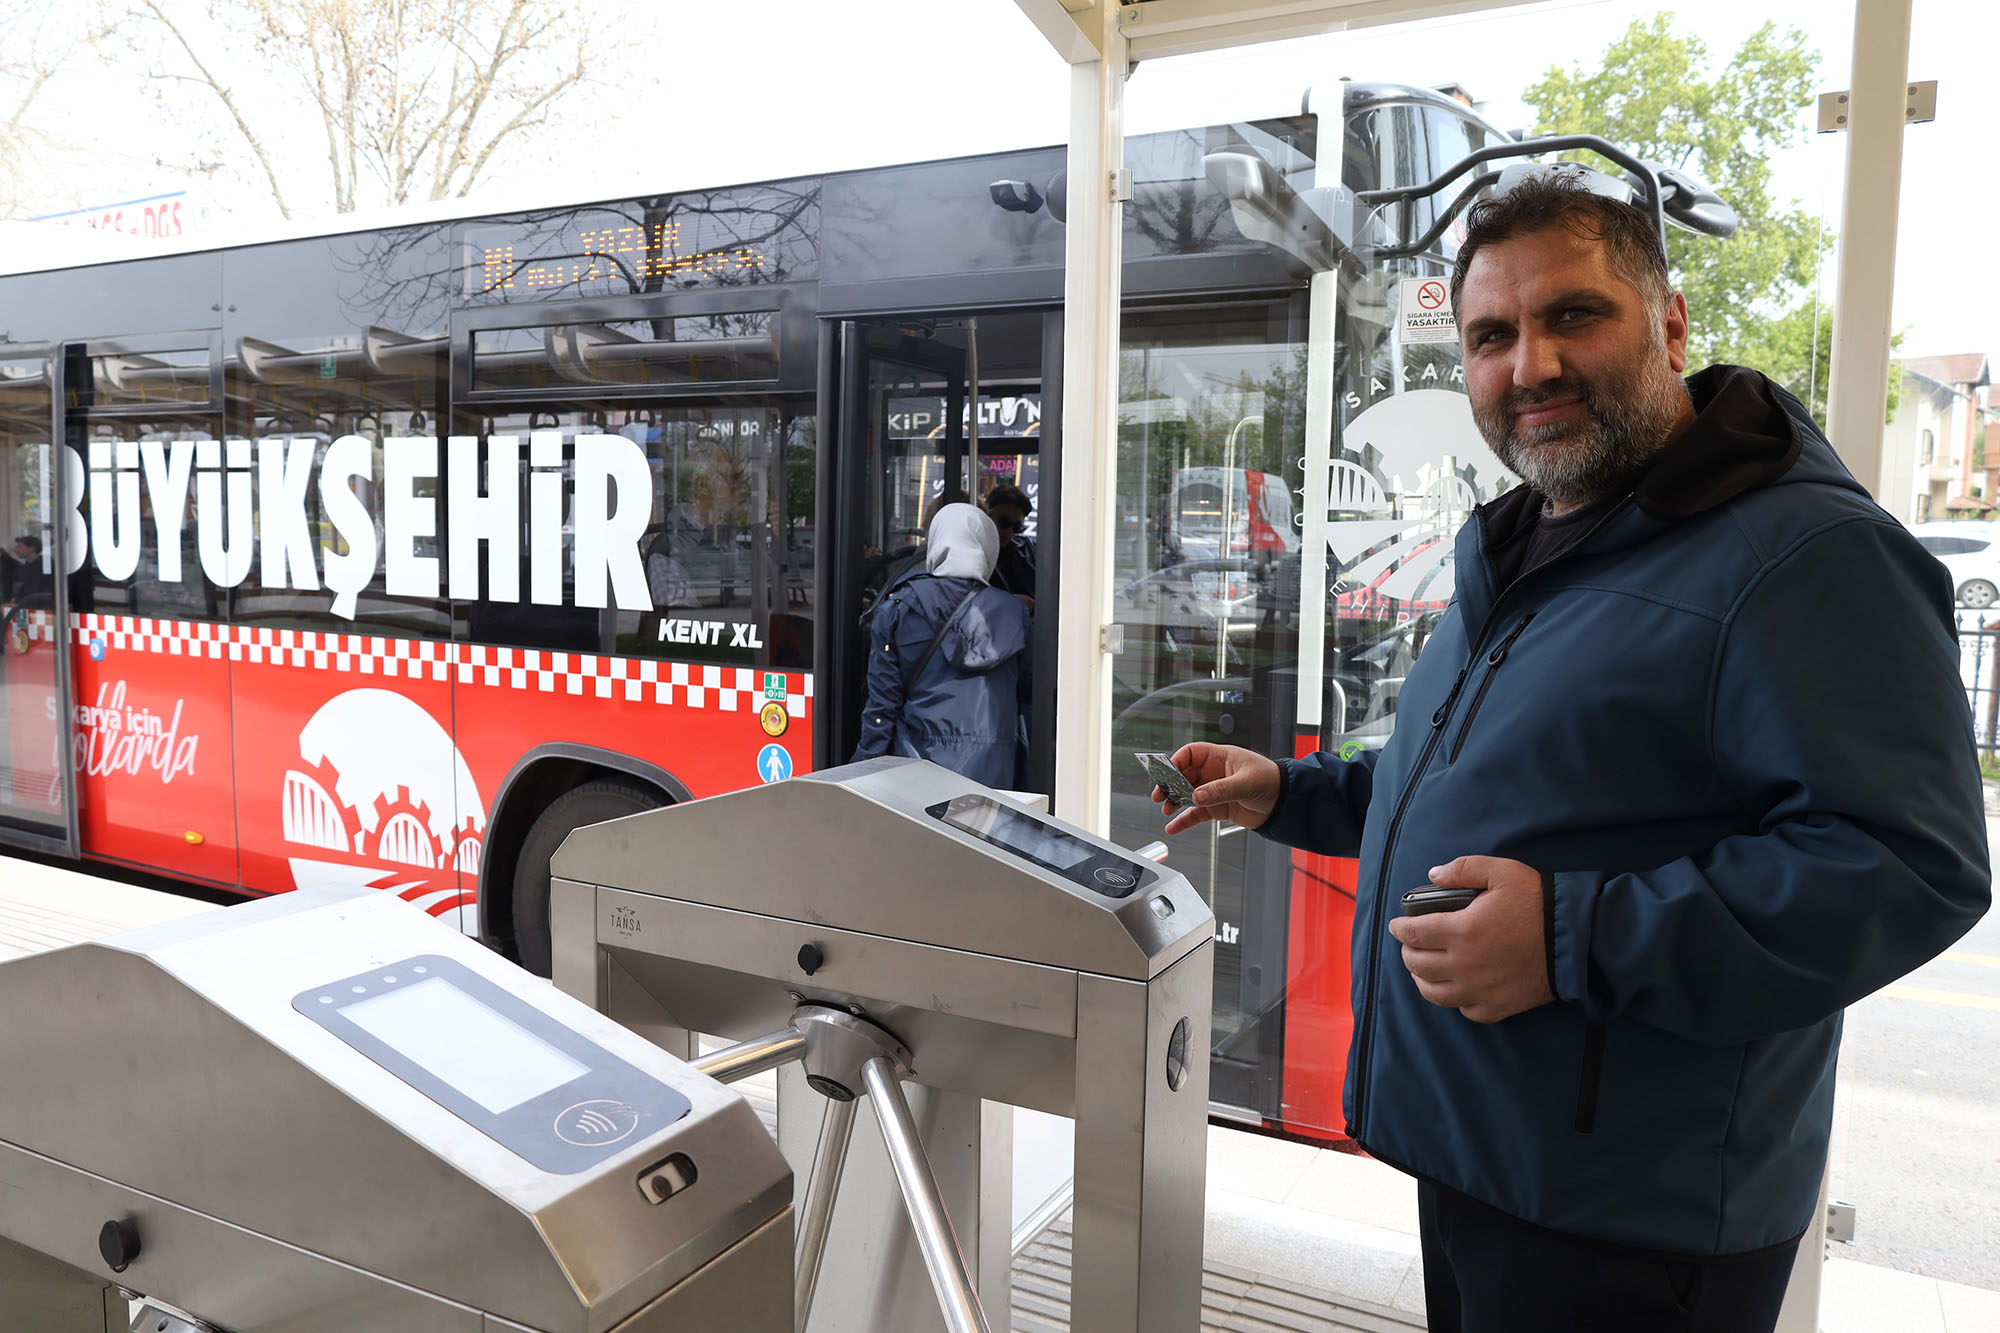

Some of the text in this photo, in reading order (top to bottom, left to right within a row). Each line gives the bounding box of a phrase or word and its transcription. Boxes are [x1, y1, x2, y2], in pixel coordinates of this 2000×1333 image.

[1406, 317, 1455, 327] YASAKTIR
[39, 431, 654, 621] BÜYÜKŞEHİR
[658, 618, 763, 649] KENT XL
[610, 914, 642, 933] TANSA
